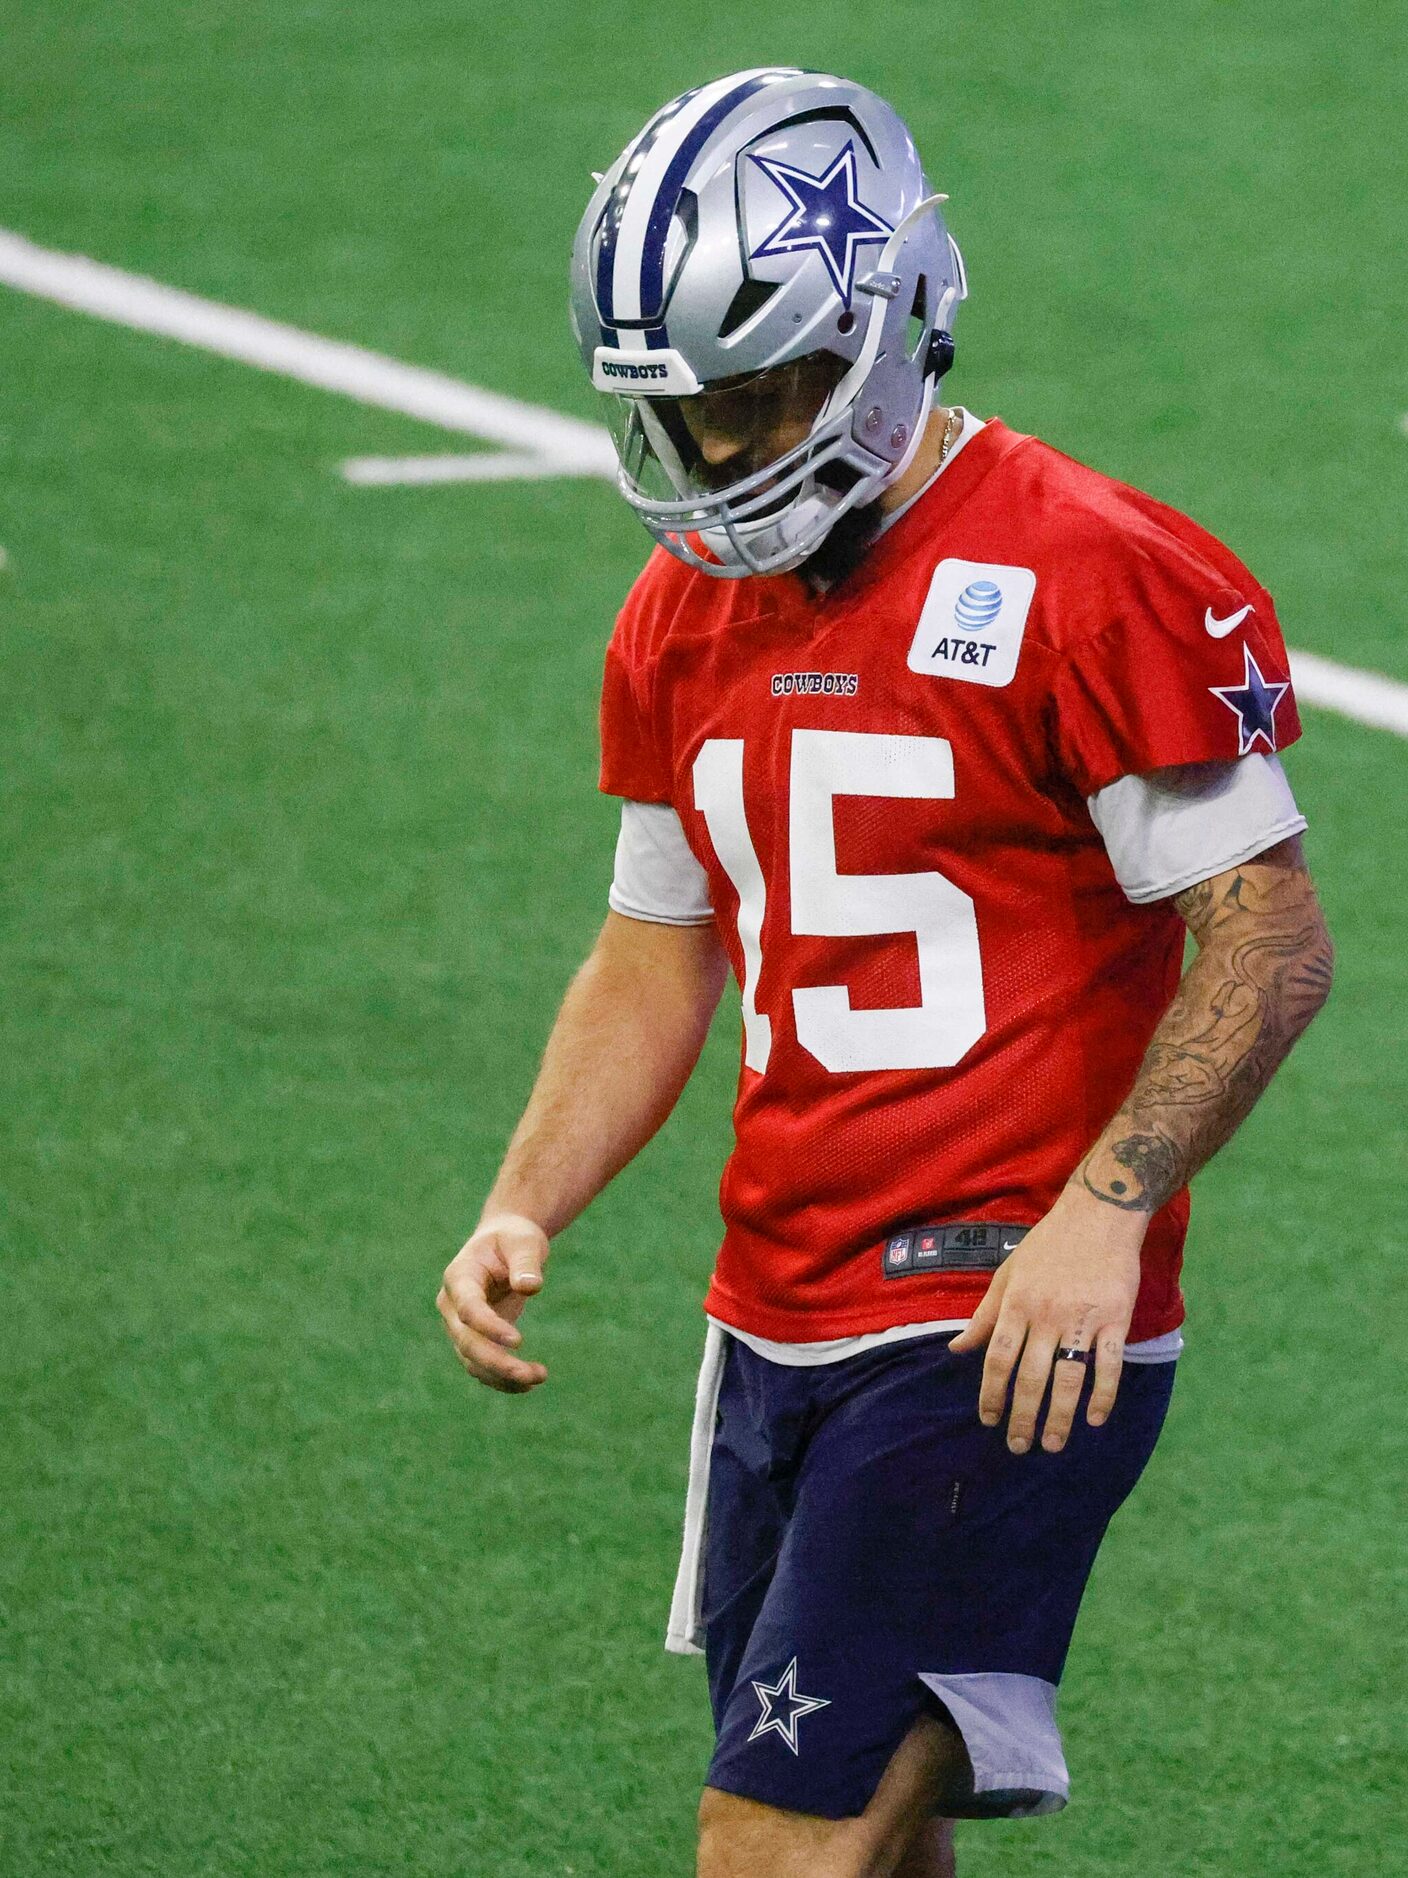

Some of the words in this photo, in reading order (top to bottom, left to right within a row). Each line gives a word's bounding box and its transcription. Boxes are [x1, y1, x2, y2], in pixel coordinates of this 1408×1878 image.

[602, 361, 668, 379] COWBOYS
[931, 637, 997, 667] AT&T
[771, 672, 858, 696] COWBOYS
[692, 728, 987, 1075] 15
